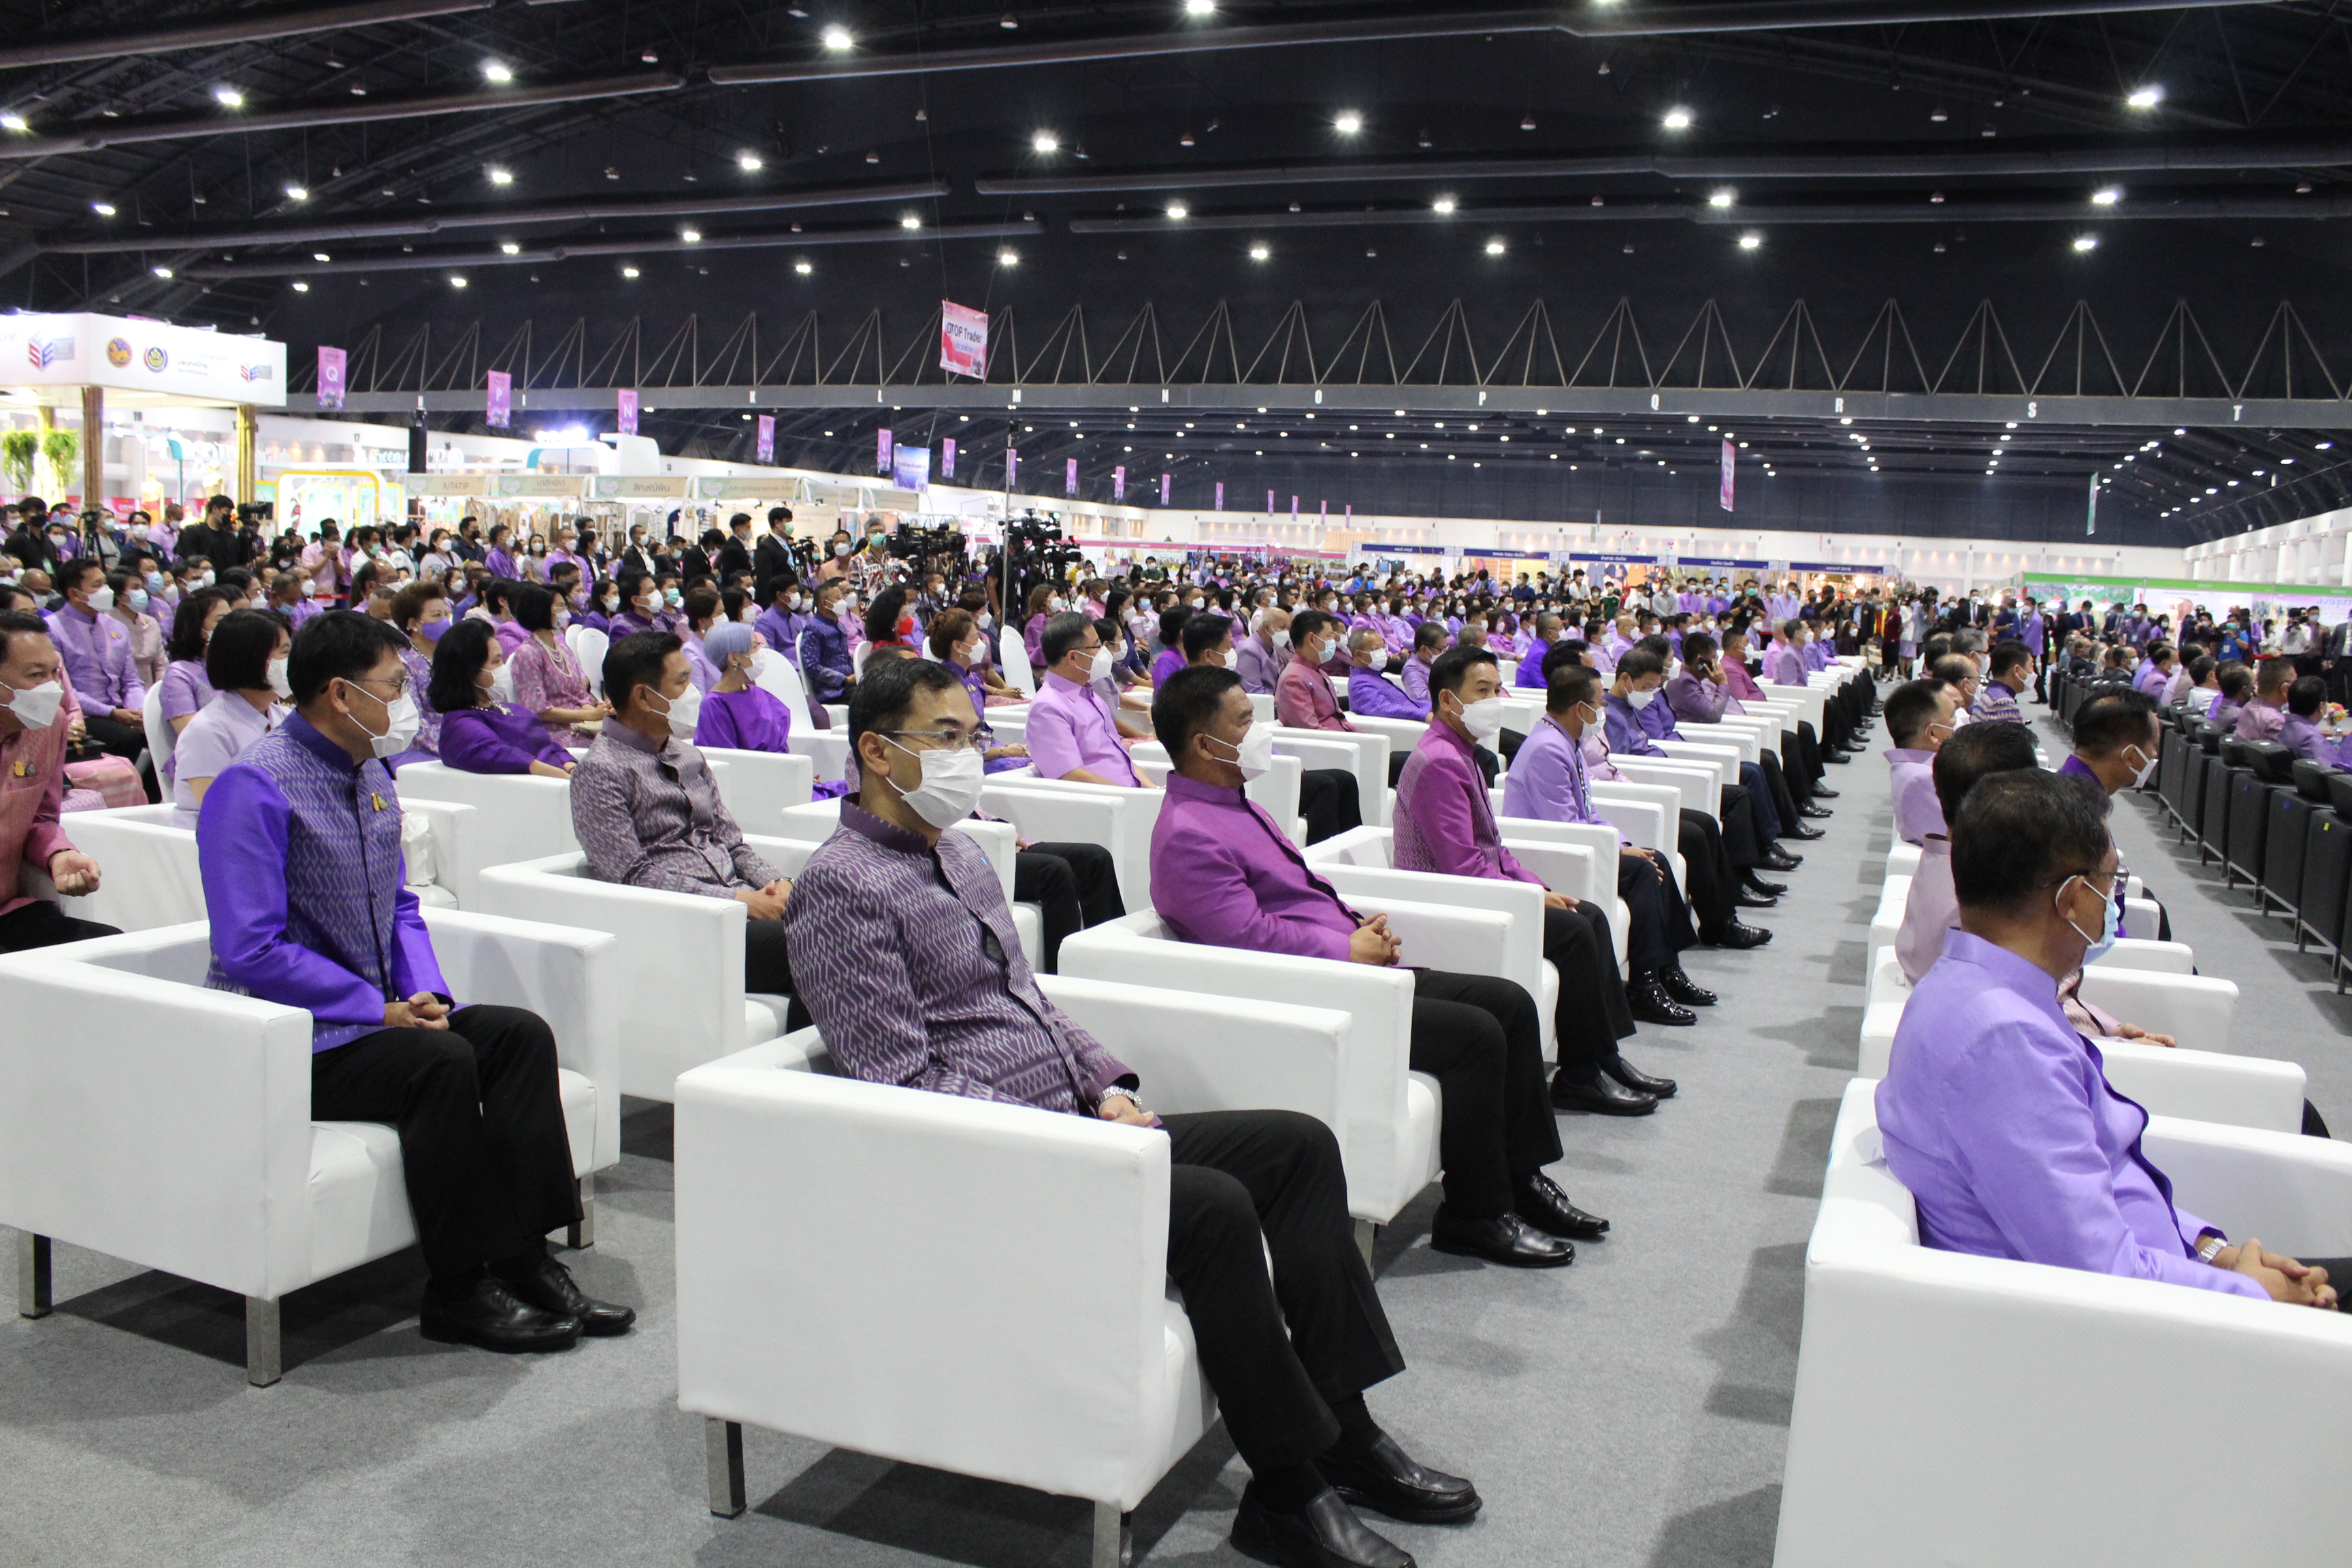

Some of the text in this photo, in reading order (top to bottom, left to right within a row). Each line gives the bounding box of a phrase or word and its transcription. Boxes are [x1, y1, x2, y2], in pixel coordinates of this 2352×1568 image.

[947, 322, 983, 343] OTOP Trader
[325, 366, 339, 382] Q
[496, 387, 503, 402] P
[749, 390, 756, 404] K
[877, 389, 883, 403] L
[1012, 389, 1022, 403] M
[1162, 389, 1169, 403] N
[1478, 391, 1488, 406] P
[1650, 393, 1660, 411] Q
[623, 404, 632, 418] N
[1835, 397, 1844, 413] R
[2027, 402, 2037, 419] S
[2233, 405, 2242, 421] T
[762, 428, 770, 441] M
[442, 481, 470, 490] JUTATIP
